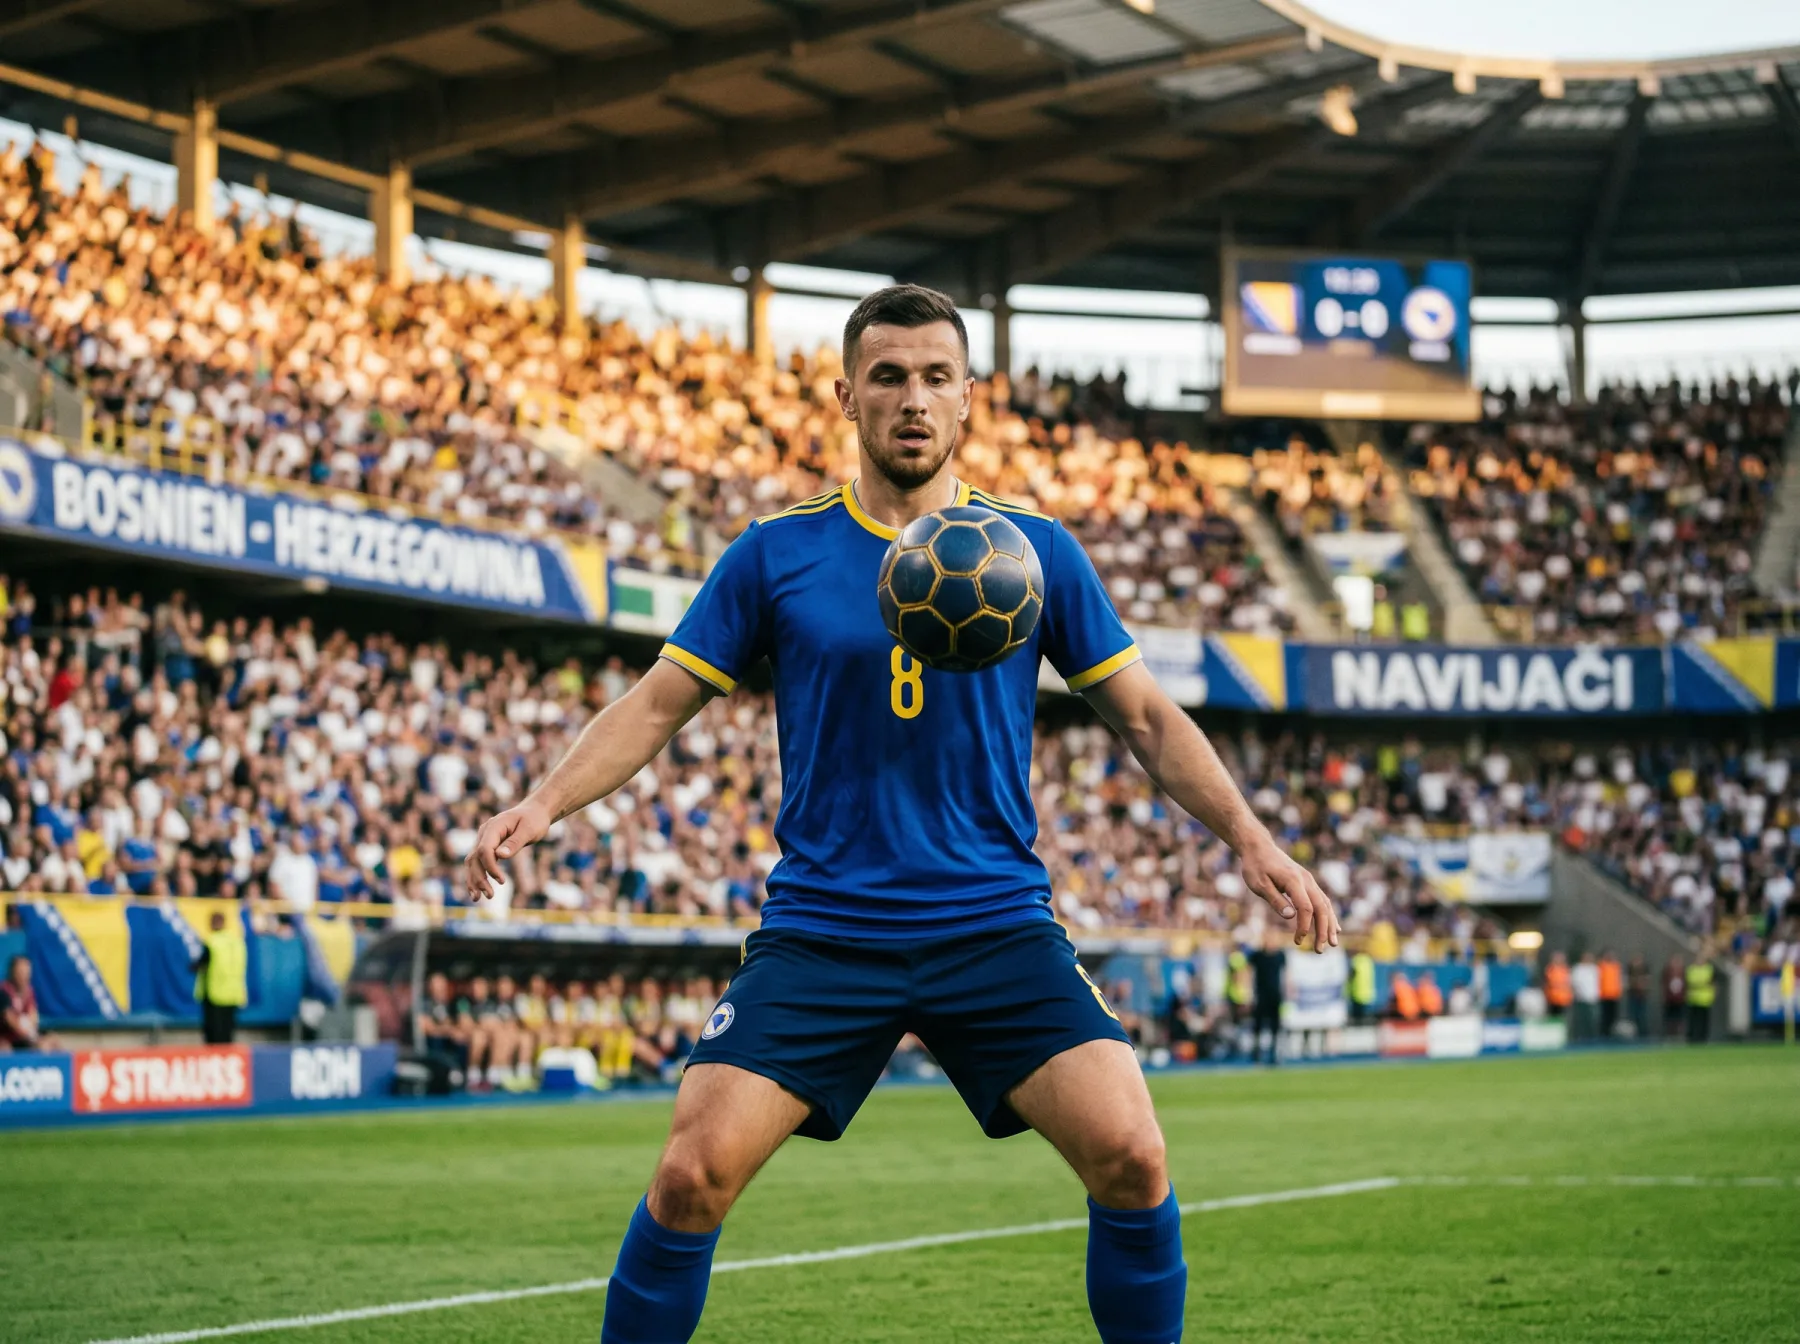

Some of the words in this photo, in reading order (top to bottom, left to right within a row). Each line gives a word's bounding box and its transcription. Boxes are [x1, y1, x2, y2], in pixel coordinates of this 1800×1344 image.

[891, 645, 924, 719] 8
[1332, 643, 1633, 710] NAVIJAČI
[0, 1066, 64, 1102] .com
[111, 1056, 246, 1102] STRAUSS
